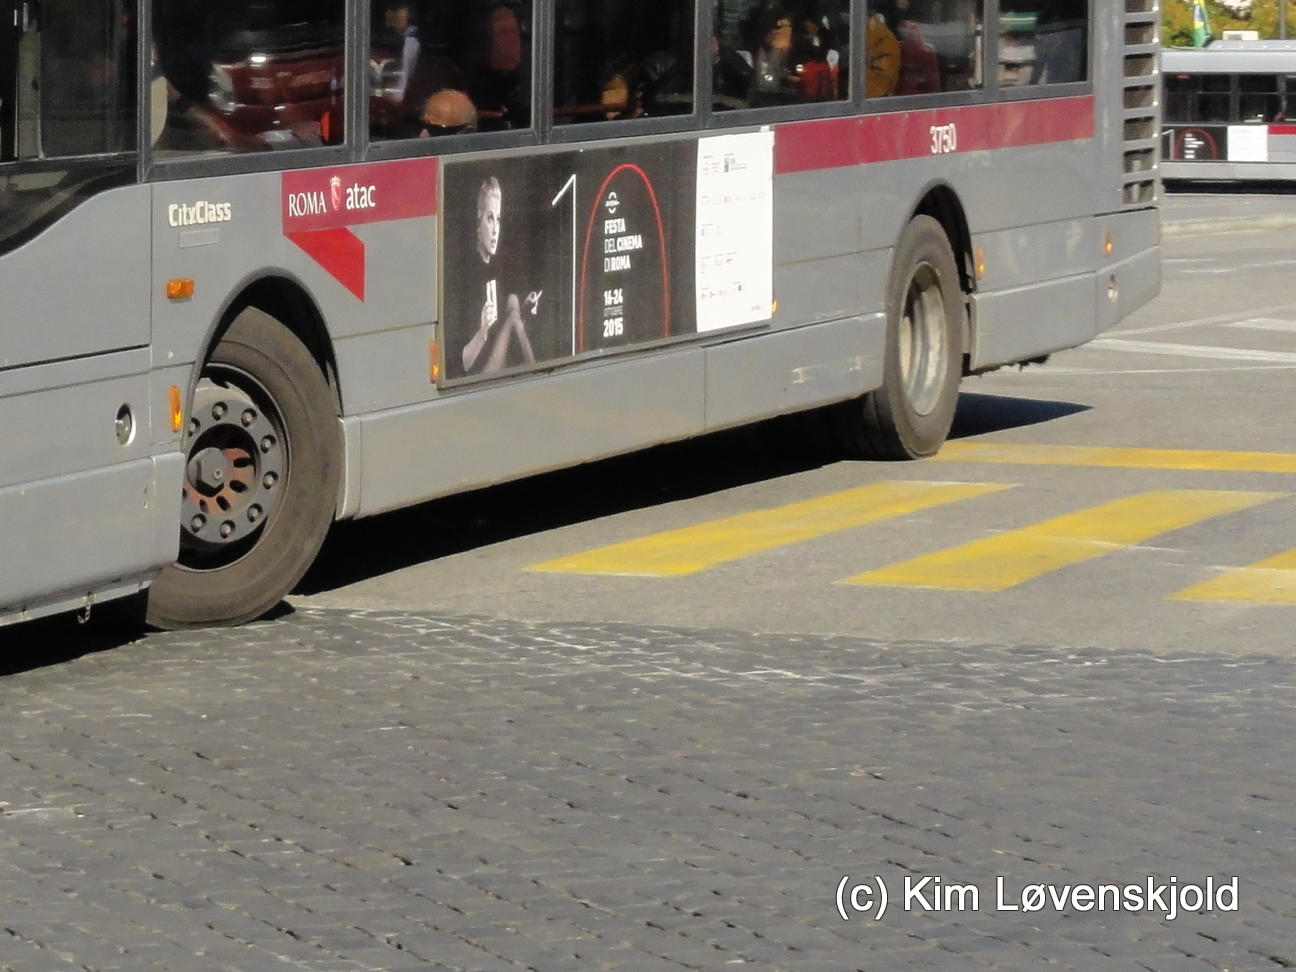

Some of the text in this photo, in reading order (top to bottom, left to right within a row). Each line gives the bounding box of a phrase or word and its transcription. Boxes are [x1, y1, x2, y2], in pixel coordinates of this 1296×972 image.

[930, 123, 957, 154] 3750
[288, 182, 376, 217] ROMA atac
[168, 200, 232, 227] CityClass
[605, 218, 626, 235] FESTA
[611, 254, 631, 271] ROMA
[603, 317, 624, 337] 2015
